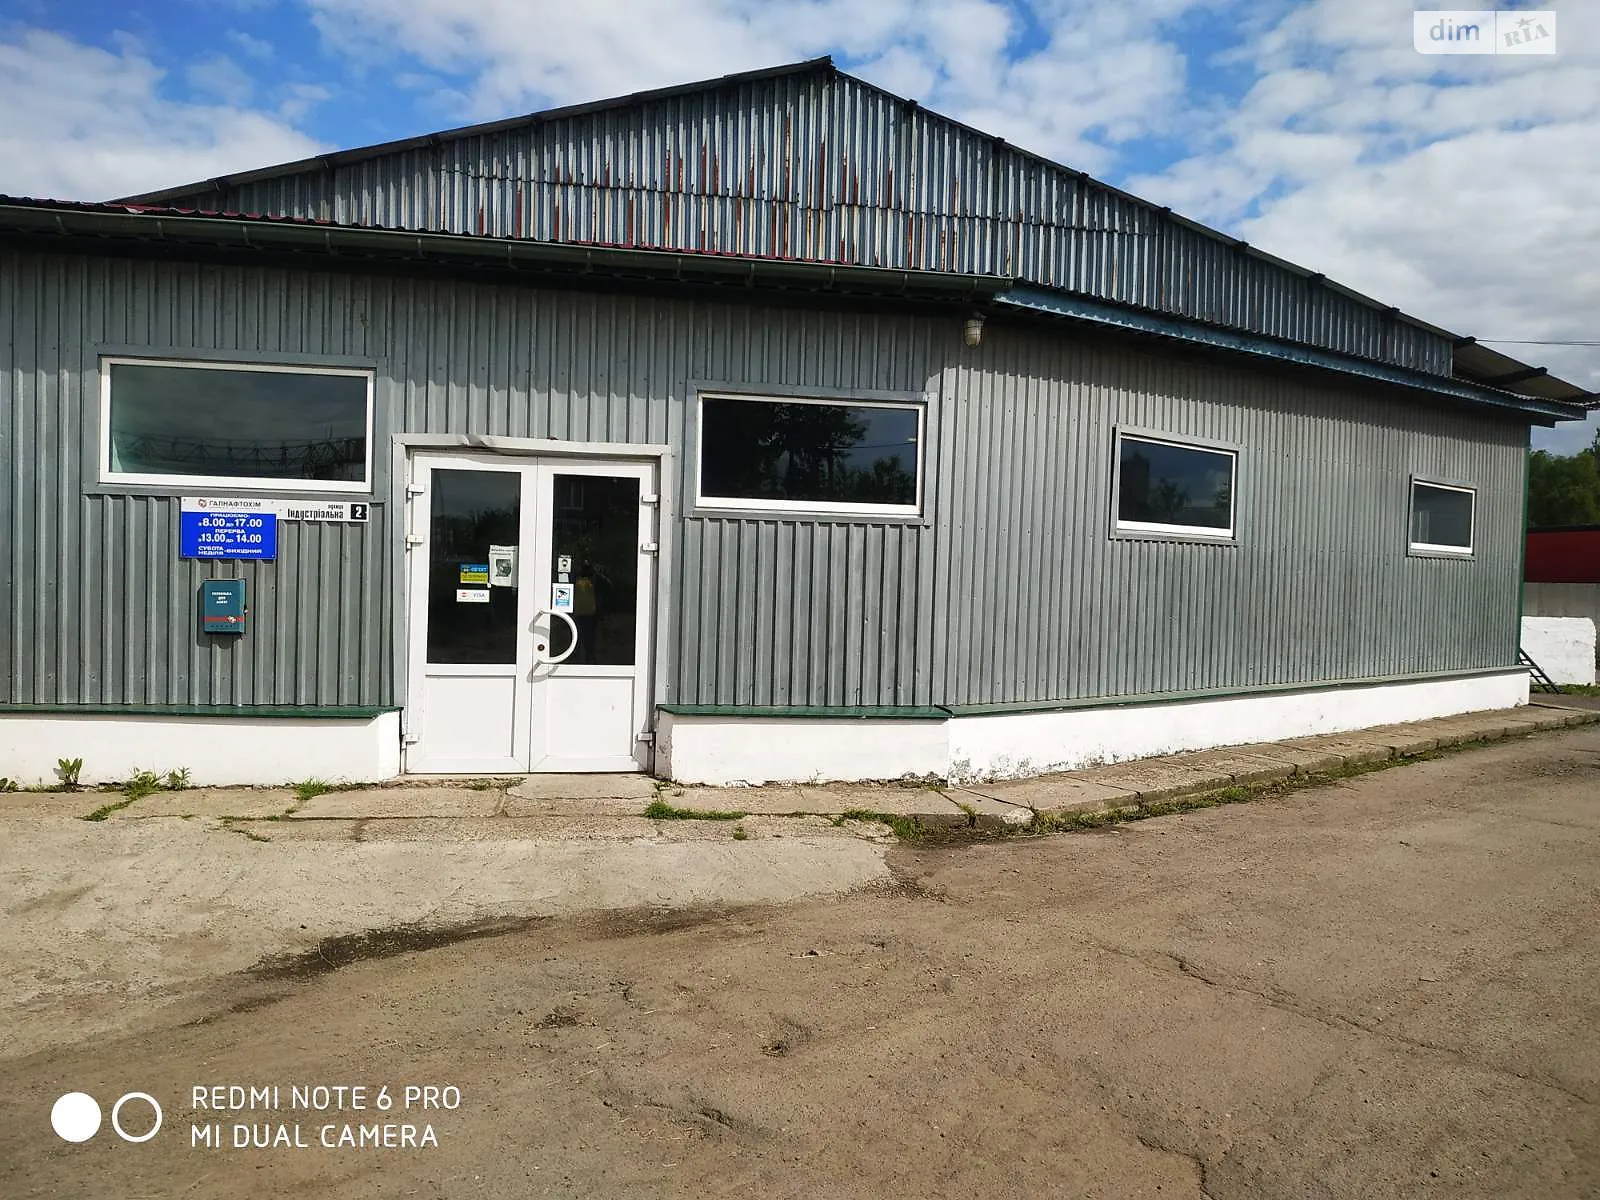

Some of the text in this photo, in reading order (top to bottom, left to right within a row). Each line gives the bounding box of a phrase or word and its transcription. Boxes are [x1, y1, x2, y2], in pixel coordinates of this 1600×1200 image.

[287, 508, 344, 520] Індустріальна
[355, 506, 363, 518] 2
[203, 518, 225, 527] 8.00
[234, 518, 262, 527] 17.00
[201, 533, 226, 542] 13.00
[235, 534, 262, 543] 14.00
